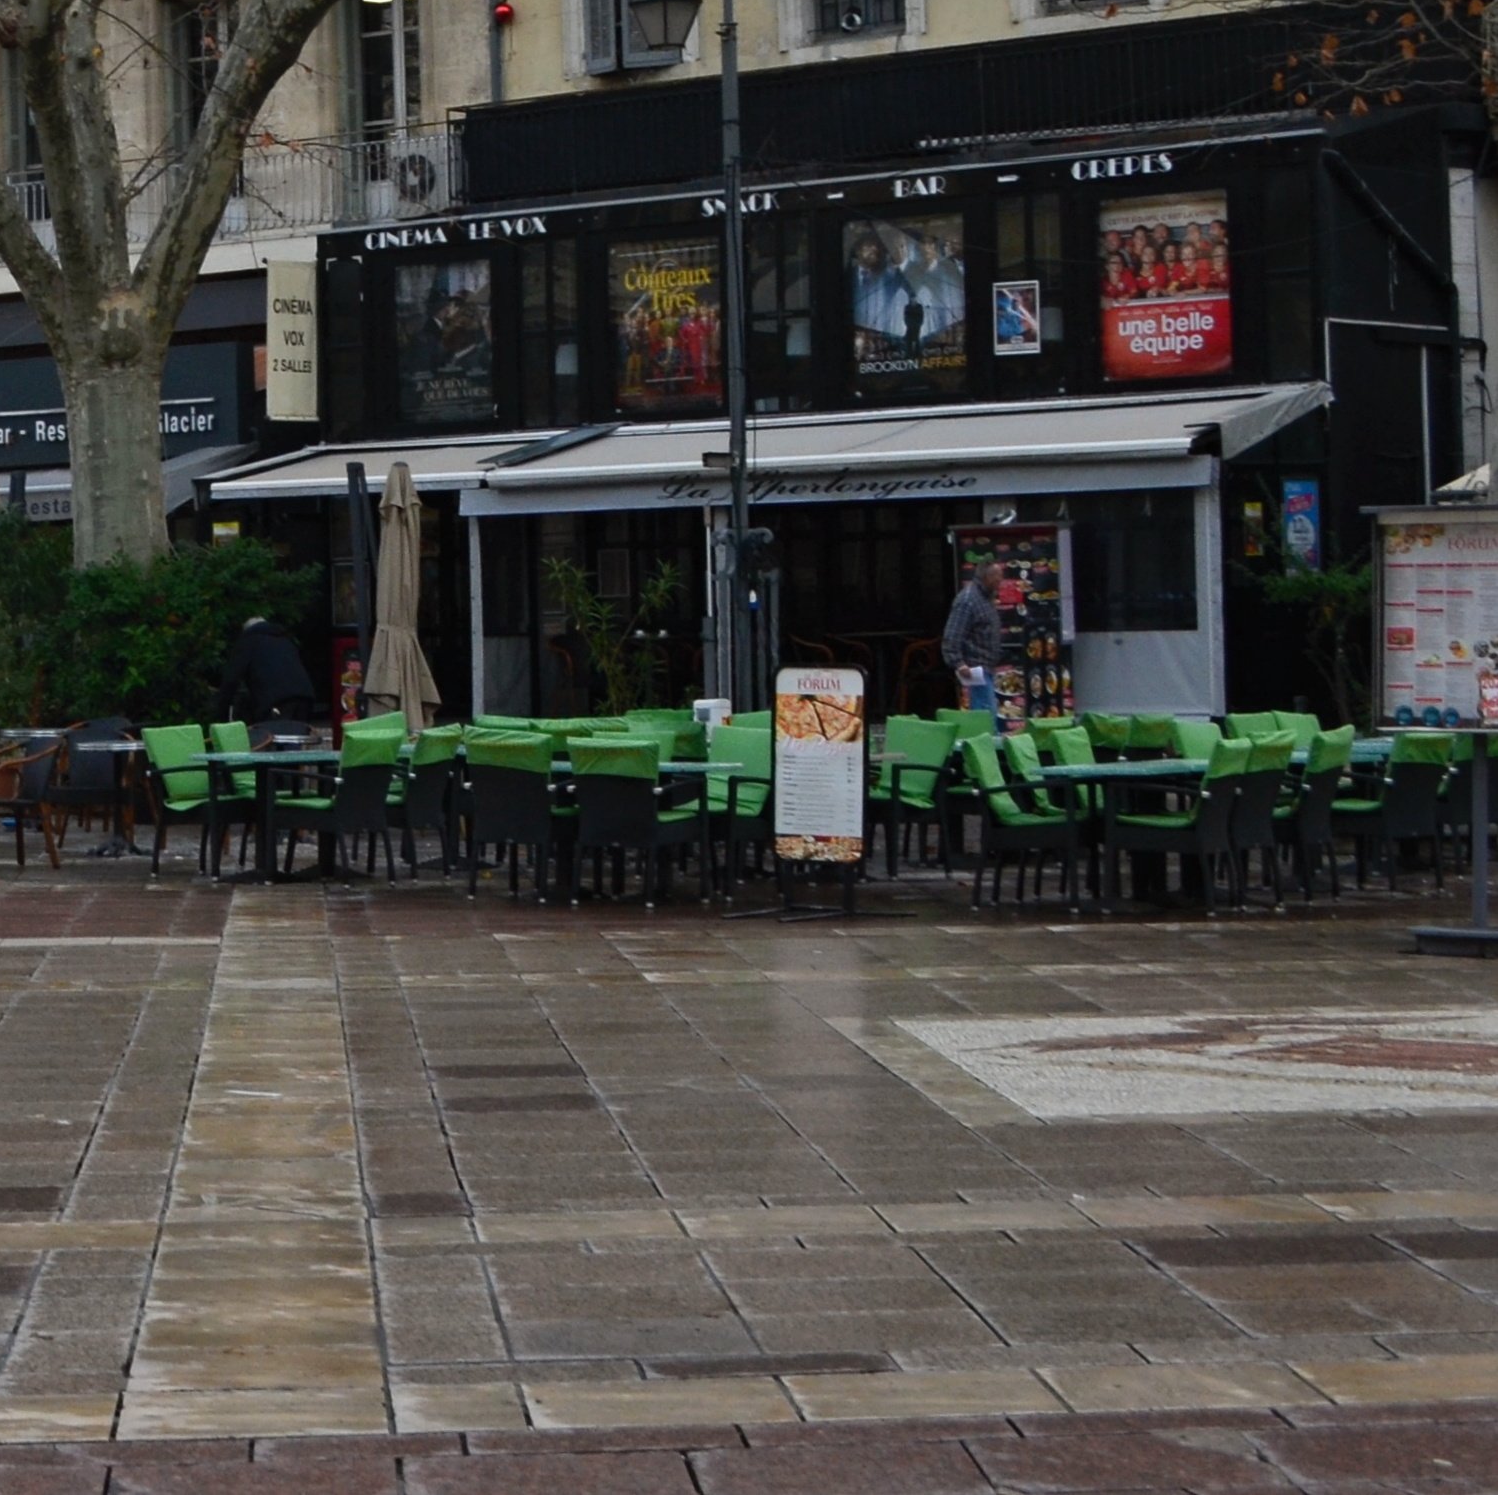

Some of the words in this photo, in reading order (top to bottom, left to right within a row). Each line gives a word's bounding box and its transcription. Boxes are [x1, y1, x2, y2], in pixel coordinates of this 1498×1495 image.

[892, 176, 946, 198] BAR
[1071, 153, 1173, 181] CREPES
[364, 226, 448, 250] CINEMA
[469, 220, 499, 240] LE
[501, 216, 547, 237] VOX
[625, 268, 711, 291] Couteaux
[273, 296, 313, 315] CINÉMA
[1118, 318, 1157, 336] une
[1161, 312, 1214, 333] belle
[283, 331, 305, 347] VOX
[1130, 333, 1204, 356] équipe
[273, 359, 279, 372] 2
[281, 359, 312, 373] SALLES
[859, 358, 919, 374] BROOKLYN
